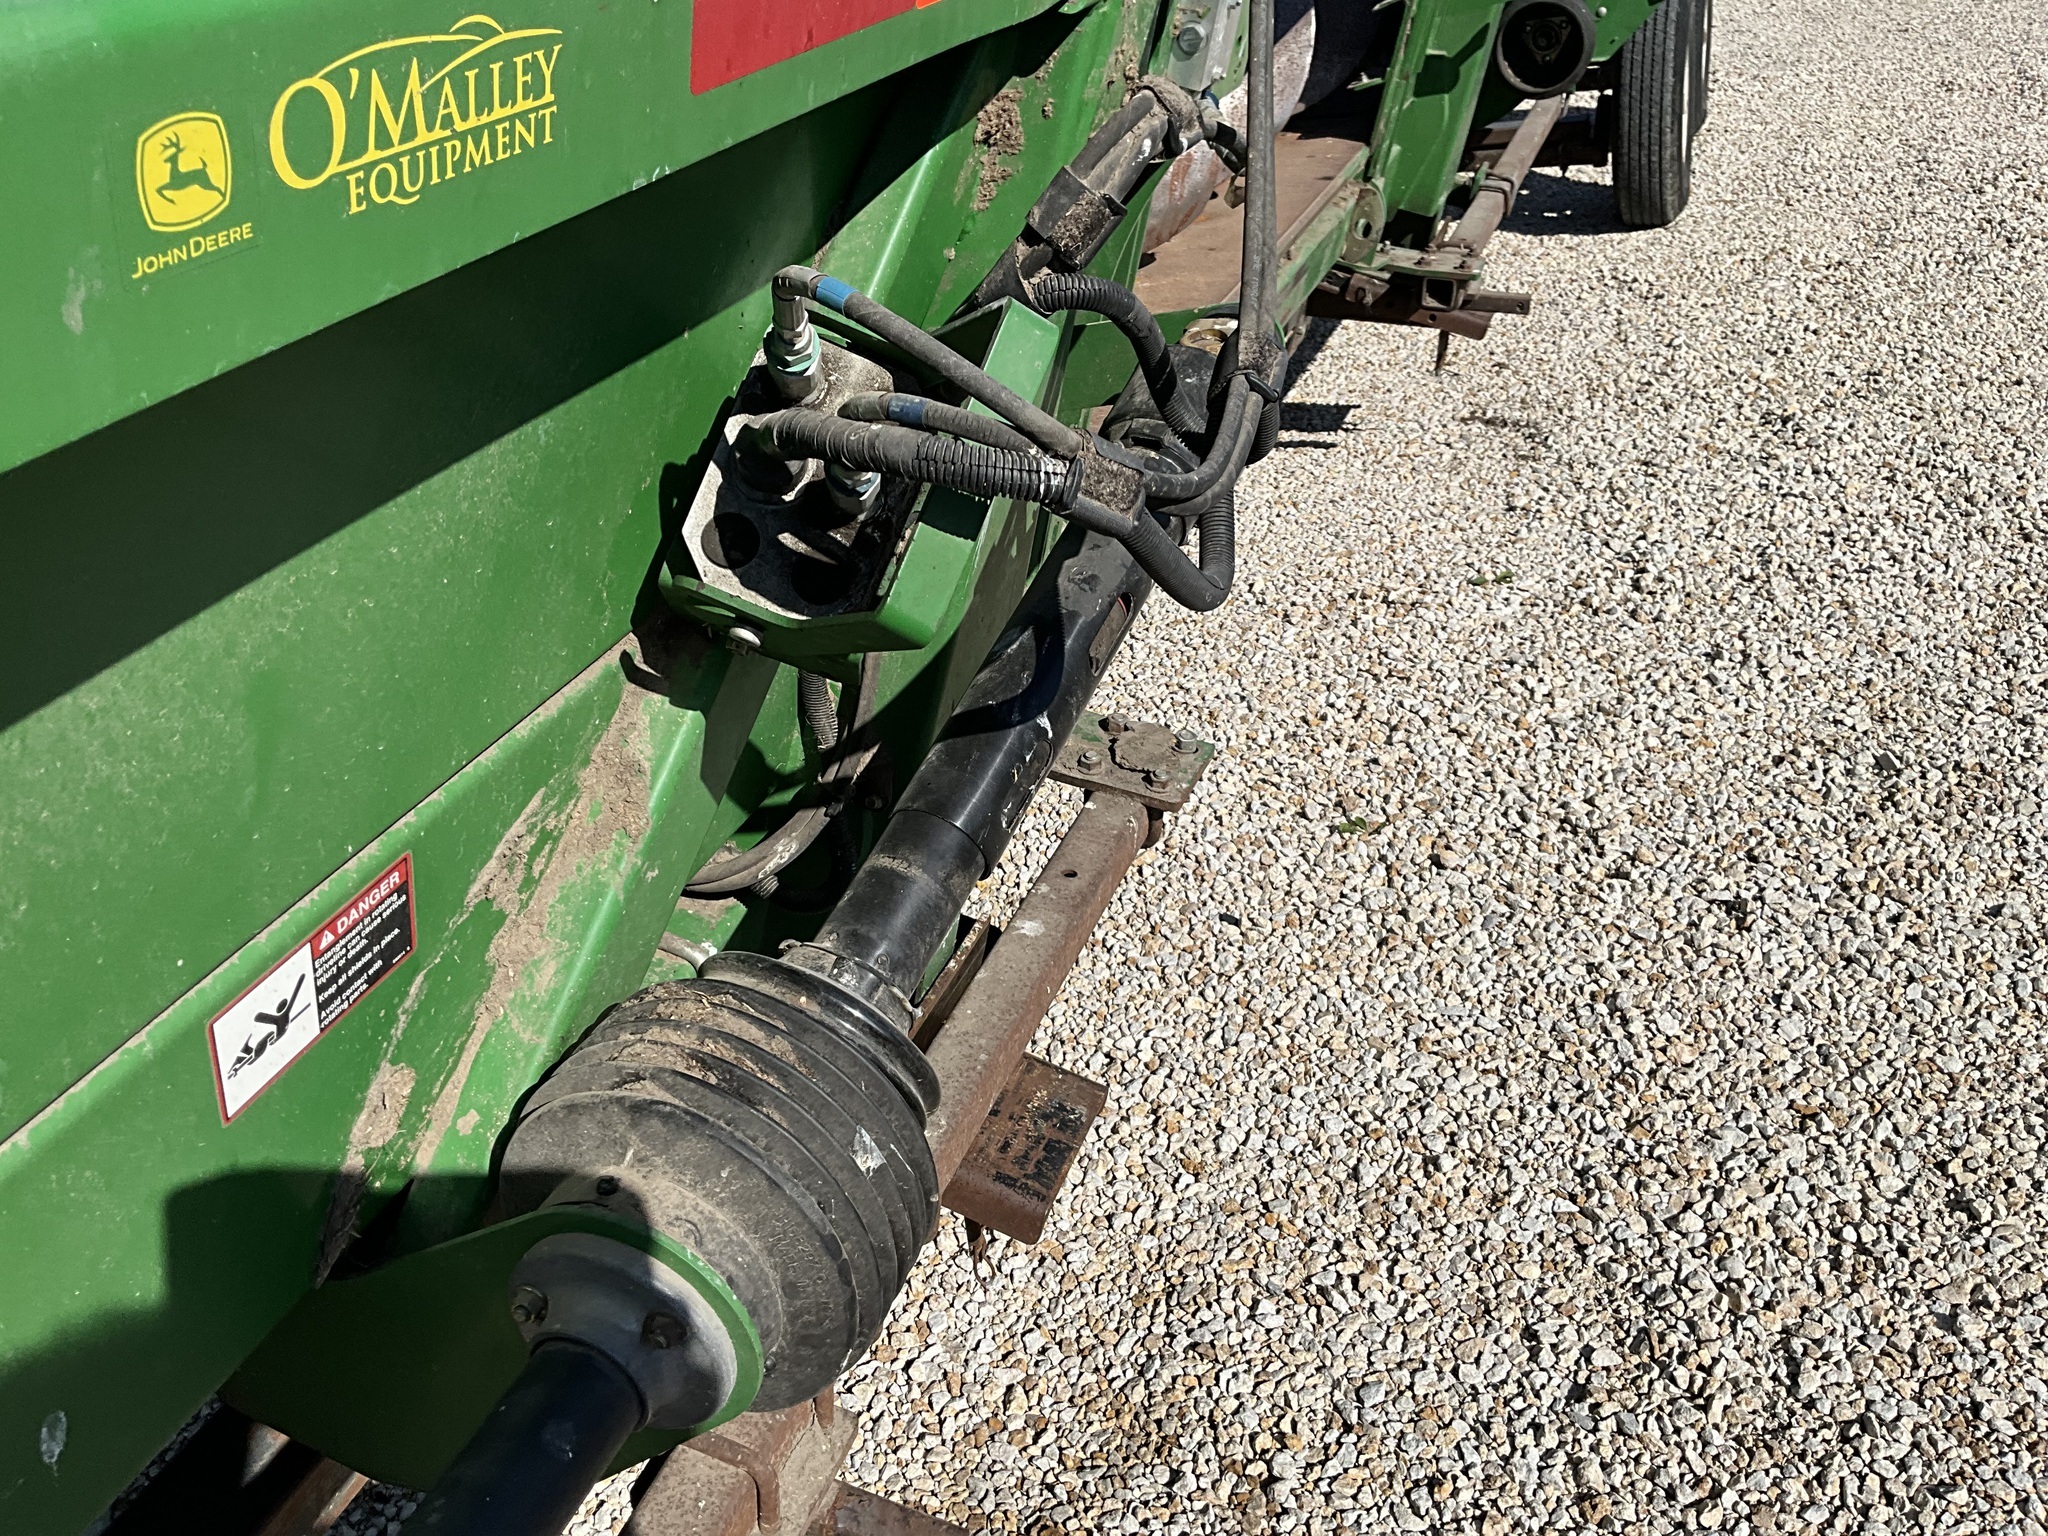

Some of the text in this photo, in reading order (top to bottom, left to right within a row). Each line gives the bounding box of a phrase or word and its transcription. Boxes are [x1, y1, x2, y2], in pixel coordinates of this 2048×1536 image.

[269, 44, 563, 190] O'MALLEY
[346, 106, 558, 216] EQUIPMENT
[131, 222, 254, 280] JOHN DEERE
[314, 922, 363, 969] Entanglement
[363, 915, 371, 926] in
[371, 892, 398, 919] rotating
[315, 894, 406, 977] driveline can cause serious
[336, 871, 400, 934] DANGER
[316, 964, 337, 987] injury
[338, 956, 346, 967] or
[347, 938, 369, 959] death.
[318, 983, 337, 1003] Keep
[337, 973, 347, 986] all
[347, 951, 372, 977] shields
[372, 944, 380, 954] in
[380, 927, 401, 949] place.
[320, 959, 383, 1020] Avoid contact with
[320, 983, 369, 1029] rotating parts.
